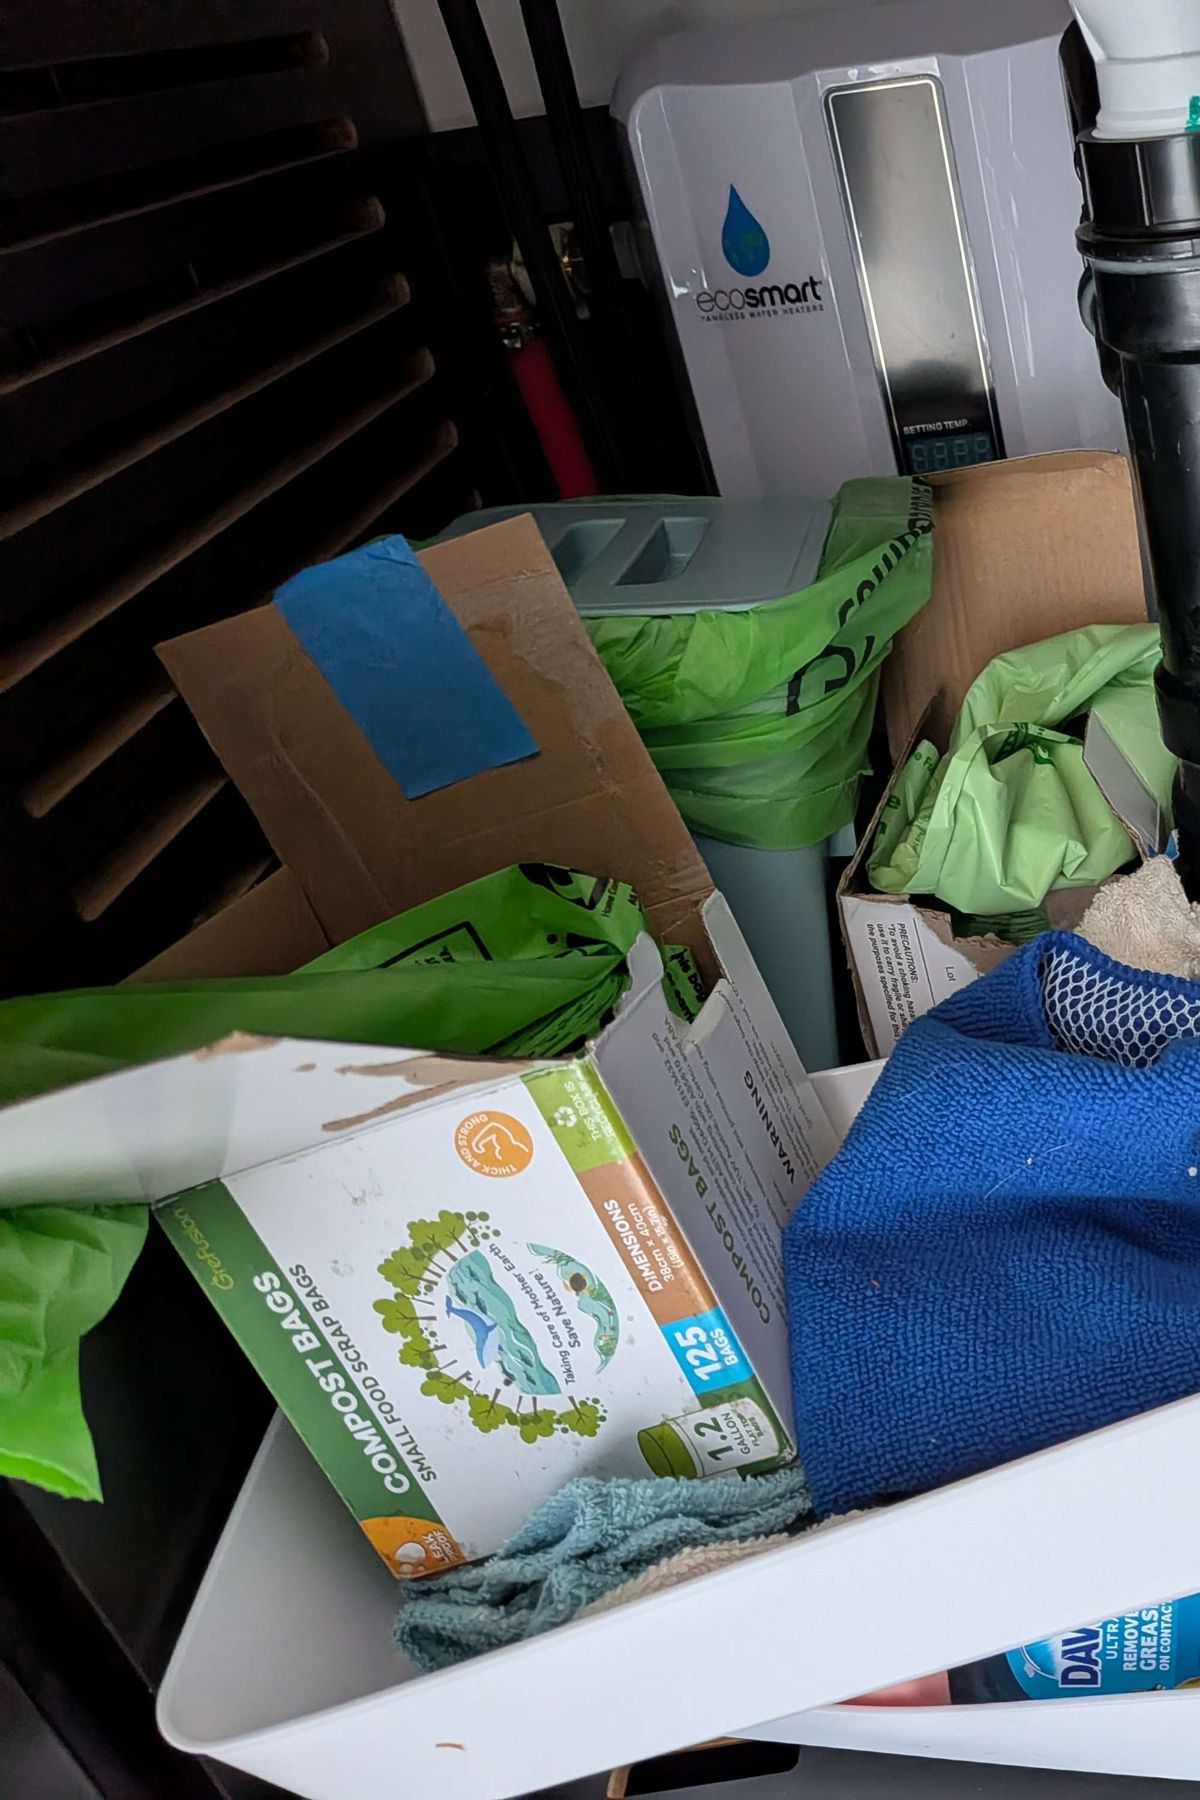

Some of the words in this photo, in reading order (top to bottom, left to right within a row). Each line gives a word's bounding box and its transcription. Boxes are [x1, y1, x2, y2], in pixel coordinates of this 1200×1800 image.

[697, 276, 822, 312] ecosmart
[783, 304, 824, 315] HEATERS
[903, 422, 943, 435] SETTING
[867, 923, 875, 937] the
[877, 923, 886, 938] use
[868, 937, 885, 975] purposes
[883, 946, 890, 955] to
[885, 955, 895, 976] carry
[897, 922, 918, 984] PRECAUTIONS:
[891, 938, 903, 960] avoid
[898, 968, 911, 999] choking
[907, 1001, 917, 1019] haza
[891, 976, 902, 1002] fragile
[945, 966, 957, 982] Lot
[880, 975, 896, 1011] specified
[896, 1003, 904, 1012] or
[889, 1011, 898, 1023] for
[892, 1022, 901, 1039] this
[564, 1081, 576, 1092] IS
[569, 1093, 589, 1116] BOX
[457, 1113, 488, 1146] STRONG
[584, 1117, 602, 1142] THIS
[743, 1070, 795, 1184] WARNING
[460, 1147, 481, 1168] AND
[481, 1164, 518, 1176] THICK
[668, 1124, 708, 1198] BAGS
[627, 1203, 650, 1237] 40cm
[175, 1208, 234, 1290] Grefusion
[489, 1243, 515, 1272] Earth
[603, 1199, 664, 1292] DIMENSIONS
[705, 1201, 770, 1324] COMPOST
[652, 1248, 675, 1282] 38cm
[289, 1263, 330, 1312] BAGS
[513, 1272, 543, 1310] Mother
[529, 1268, 566, 1317] Nature!
[253, 1271, 321, 1353] BAGS
[537, 1311, 551, 1322] of
[322, 1315, 368, 1373] SCRAP
[547, 1324, 563, 1348] Care
[562, 1318, 581, 1348] Save
[711, 1328, 739, 1366] BAGS
[559, 1350, 576, 1386] Taking
[674, 1326, 722, 1381] 125
[362, 1375, 402, 1425] FOOD
[305, 1358, 410, 1494] COMPOST
[722, 1412, 751, 1454] GALLON
[737, 1413, 750, 1428] TOP
[395, 1424, 438, 1482] SMALL
[745, 1428, 760, 1448] FLAT
[422, 1533, 450, 1562] LEAK
[1140, 1603, 1159, 1671] GREAS
[1060, 1627, 1101, 1688] DA
[1159, 1655, 1170, 1671] ON
